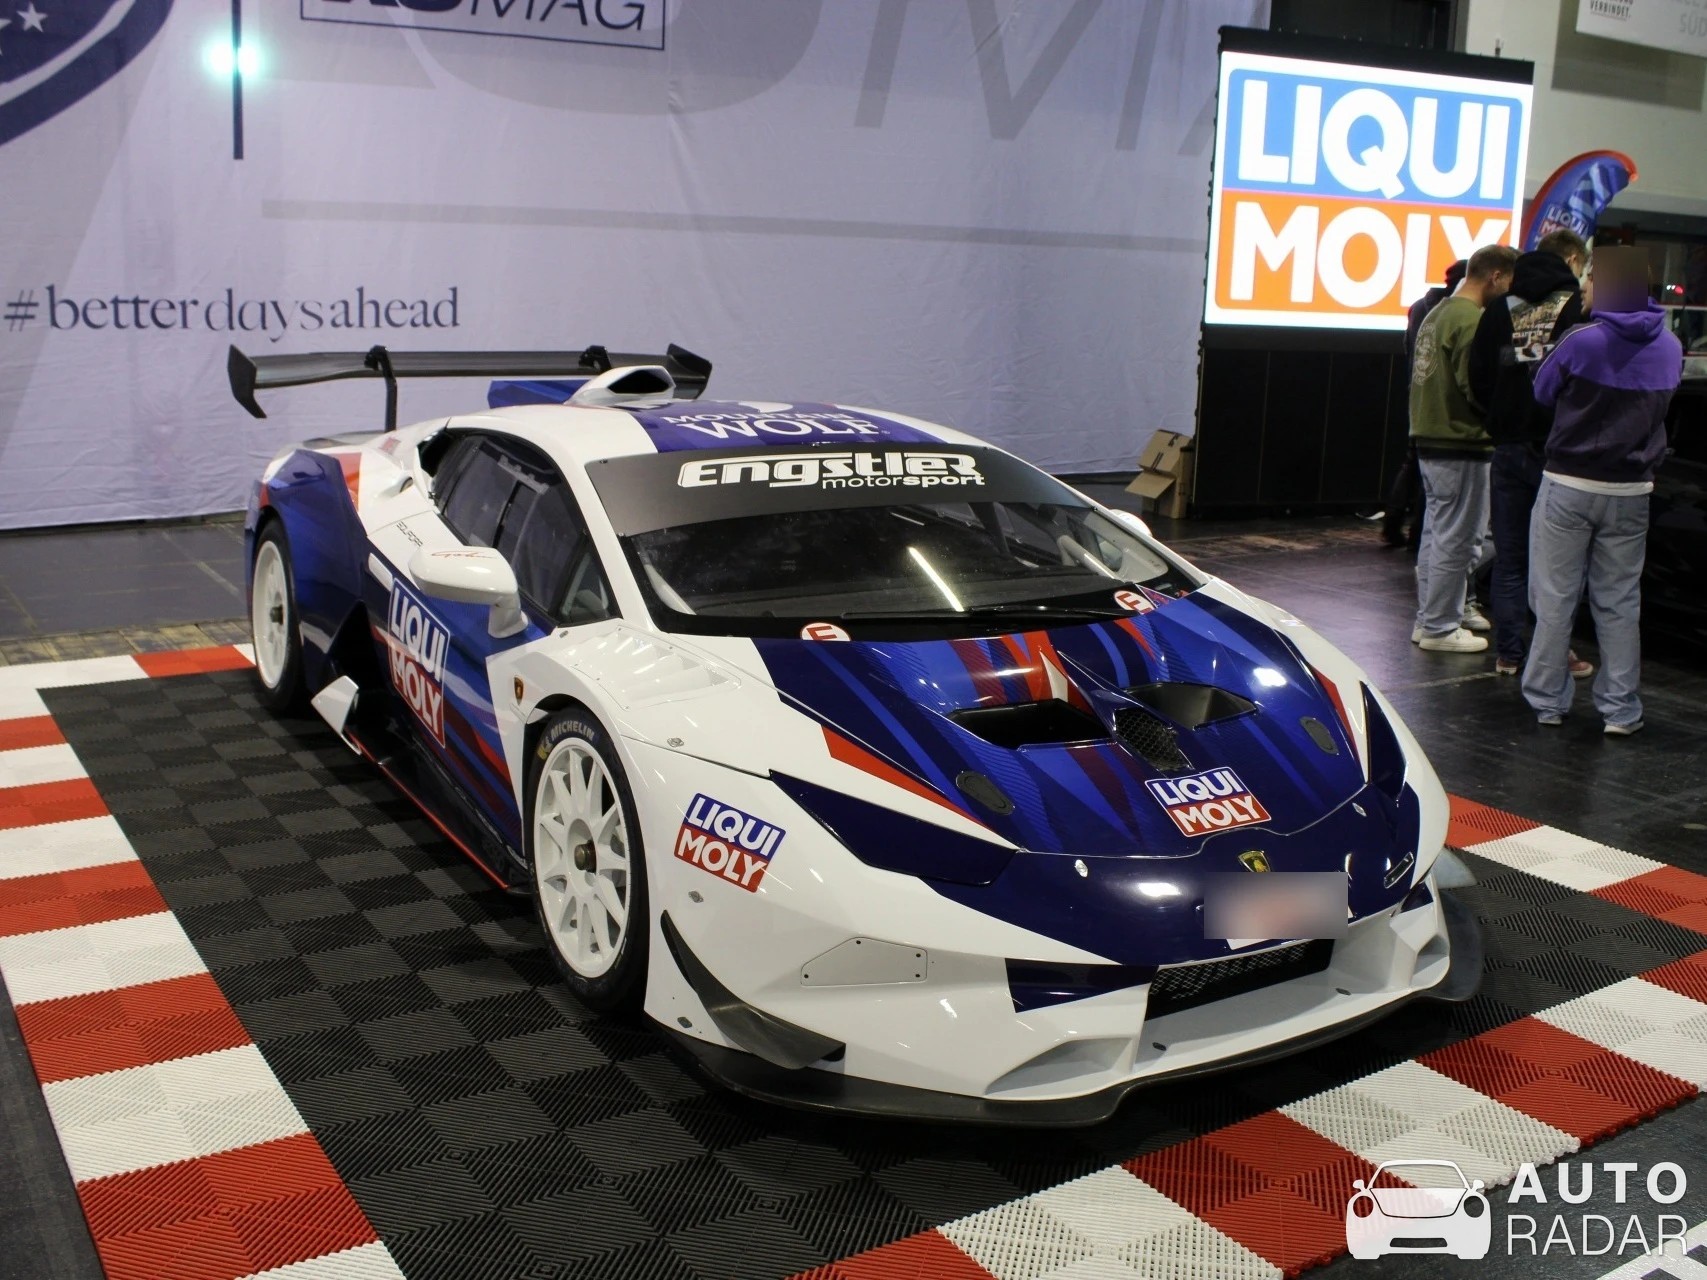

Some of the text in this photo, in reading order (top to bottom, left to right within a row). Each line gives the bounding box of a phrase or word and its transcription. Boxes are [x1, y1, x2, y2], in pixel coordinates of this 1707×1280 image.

[1238, 79, 1510, 200] LIQUI
[1548, 206, 1590, 236] LIQUI
[1231, 201, 1509, 308] MOLY
[660, 413, 855, 424] MOUNTAIN
[676, 419, 879, 439] WOLF
[822, 474, 985, 489] motorsport
[391, 587, 446, 682] LIQUI
[391, 643, 442, 735] MOLY
[550, 720, 595, 742] MICHELIN
[1152, 770, 1244, 806] LIQUI
[687, 796, 781, 857] LIQUI
[1172, 795, 1261, 833] MOLY
[677, 827, 768, 887] MOLY
